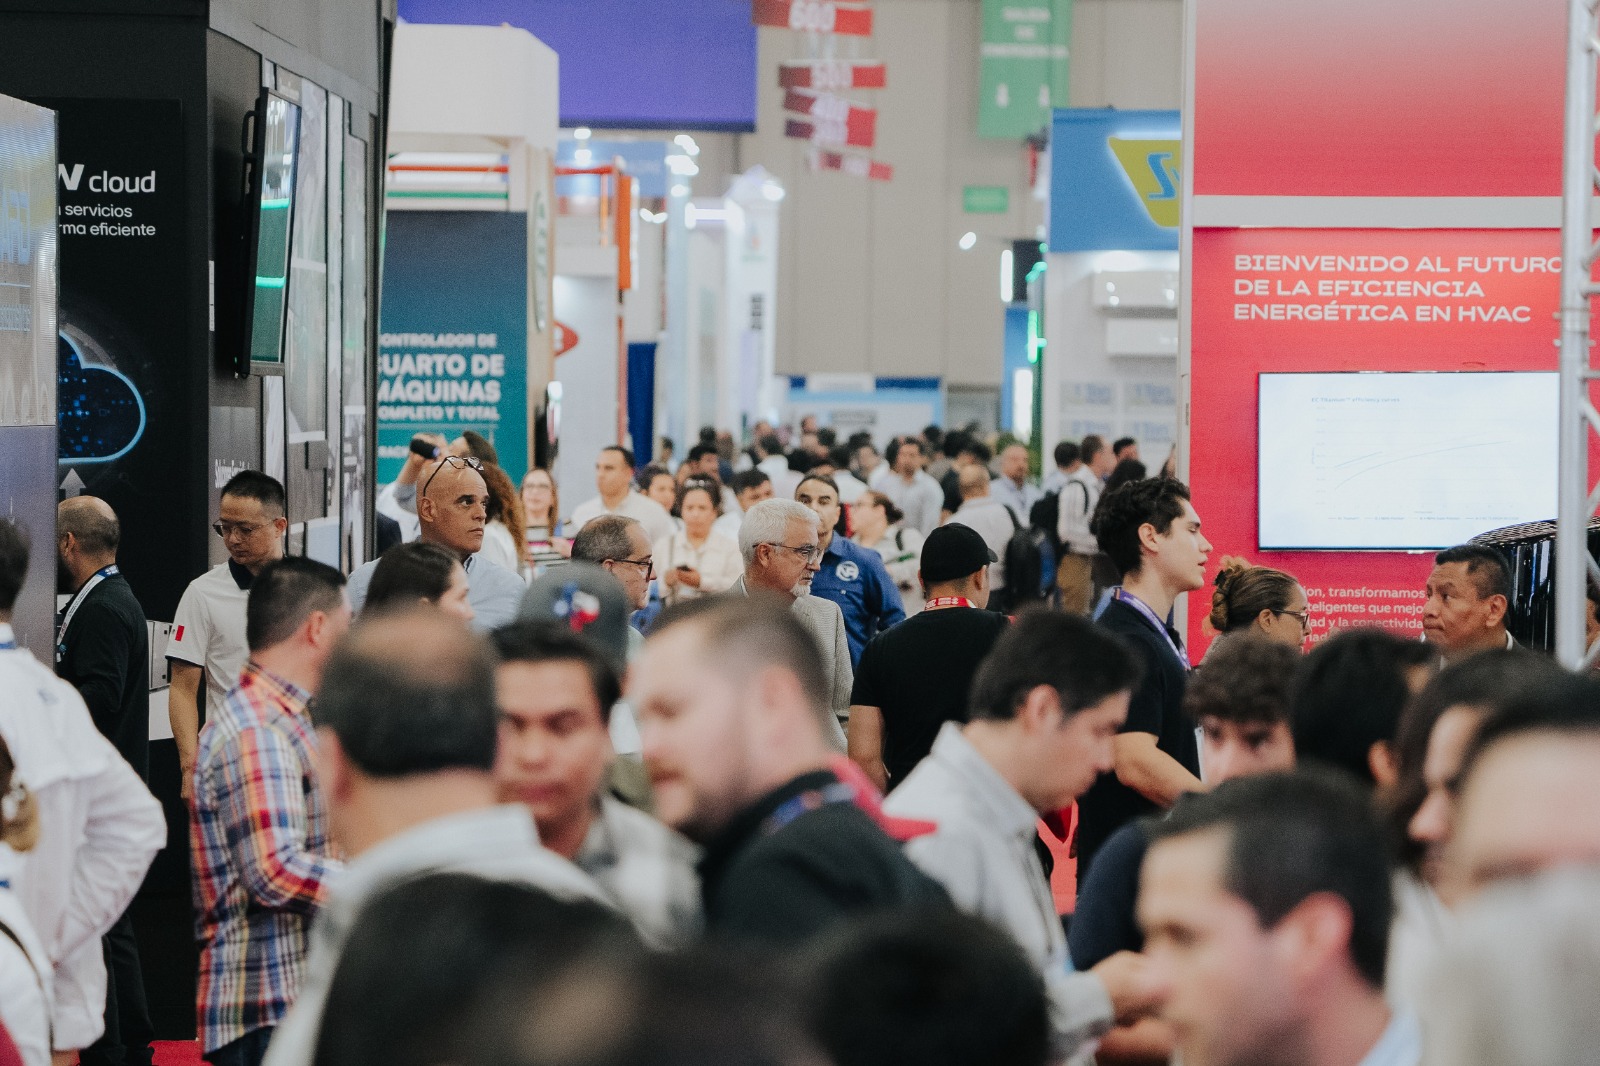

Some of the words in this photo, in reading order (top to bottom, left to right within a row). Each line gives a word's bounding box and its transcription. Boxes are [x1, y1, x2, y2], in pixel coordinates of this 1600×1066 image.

[88, 170, 156, 193] cloud
[1147, 152, 1180, 199] S
[65, 203, 133, 218] servicios
[89, 222, 156, 237] eficiente
[1234, 254, 1409, 273] BIENVENIDO
[1415, 255, 1450, 273] AL
[1234, 279, 1270, 296] DE
[1276, 279, 1311, 296] LA
[1318, 279, 1485, 298] EFICIENCIA
[1234, 299, 1409, 321] ENERGÉTICA
[1415, 305, 1450, 322] EN
[1458, 305, 1531, 322] HVAC
[379, 333, 476, 347] ONTROLADOR
[477, 333, 497, 347] DE
[378, 353, 466, 376] UARTO
[471, 354, 504, 376] DE
[378, 405, 444, 420] OMPLETO
[445, 406, 456, 420] Y
[457, 406, 500, 420] TOTAL
[1328, 586, 1426, 599] transformamos
[1367, 604, 1391, 615] que
[1393, 604, 1424, 616] mejo
[1328, 619, 1336, 629] y
[1338, 617, 1350, 628] la
